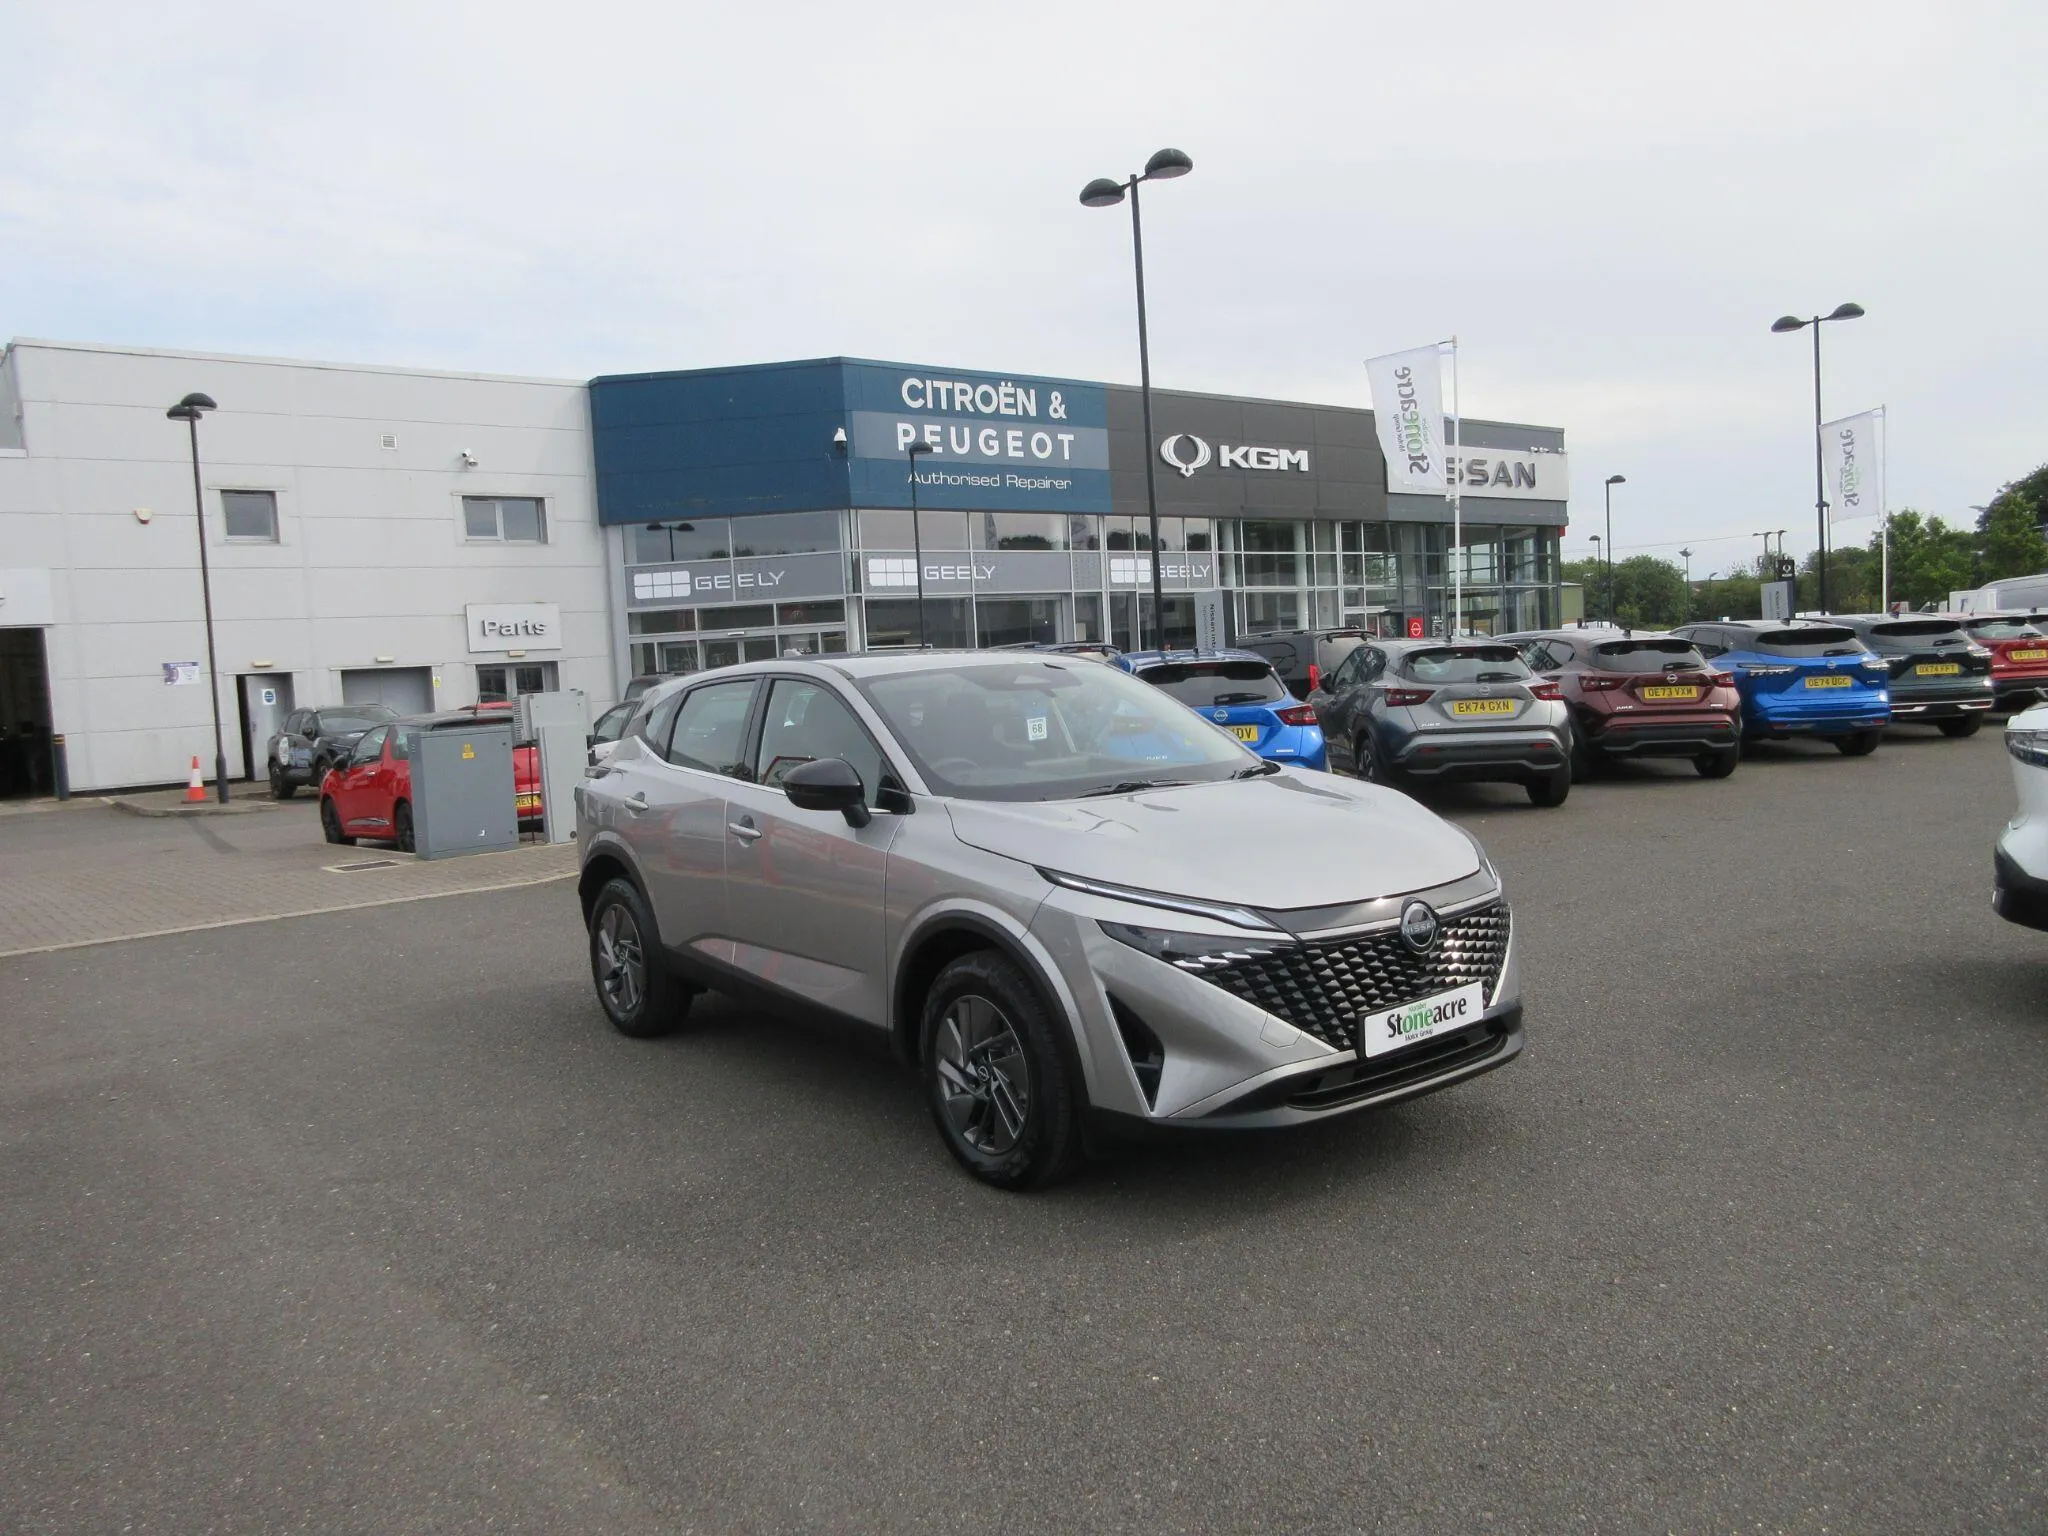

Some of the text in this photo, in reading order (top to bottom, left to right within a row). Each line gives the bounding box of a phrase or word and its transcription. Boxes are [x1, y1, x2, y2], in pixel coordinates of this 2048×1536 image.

[901, 378, 1067, 419] CITROËN &
[897, 422, 1075, 460] PEUGEOT
[1219, 445, 1309, 472] KGM
[908, 471, 1072, 491] Authorised Repairer
[695, 570, 785, 590] GEELY
[924, 565, 995, 580] GEELY
[481, 619, 546, 637] Parts
[1458, 700, 1510, 713] EK74 GXN
[1032, 723, 1043, 734] 68
[1386, 998, 1467, 1039] Stoneacre
